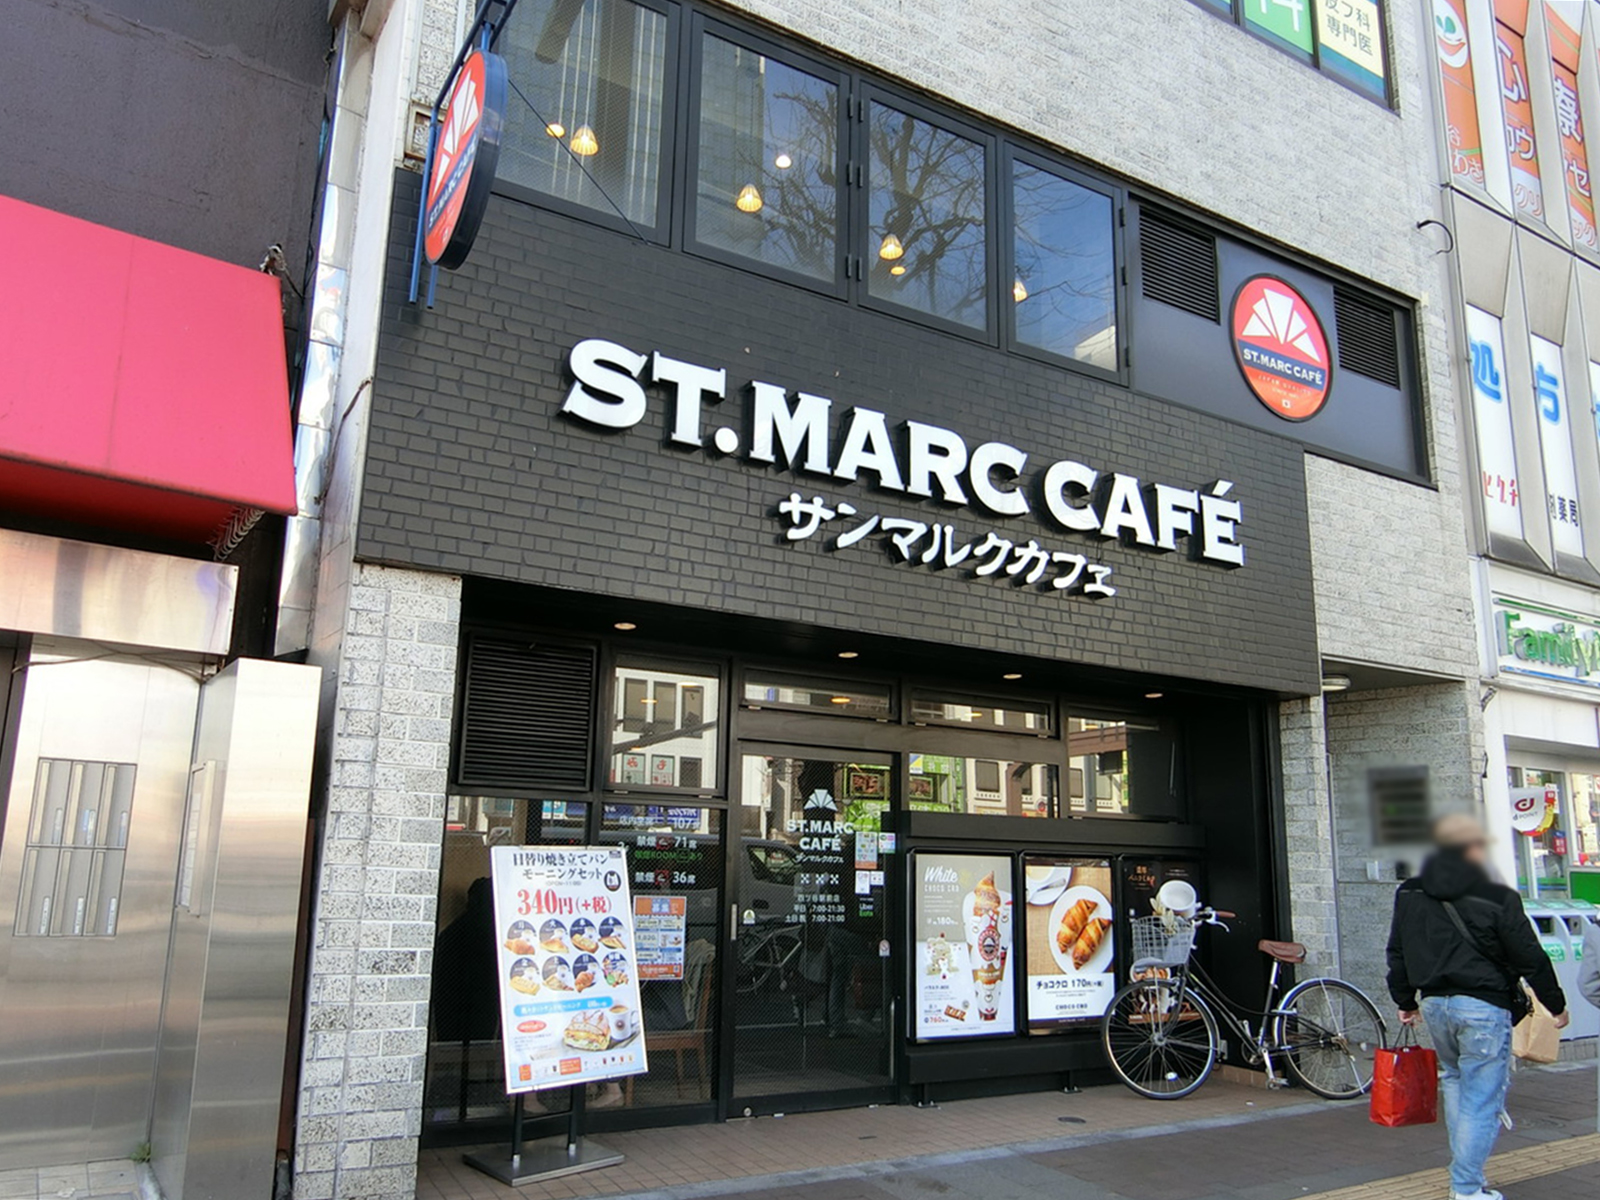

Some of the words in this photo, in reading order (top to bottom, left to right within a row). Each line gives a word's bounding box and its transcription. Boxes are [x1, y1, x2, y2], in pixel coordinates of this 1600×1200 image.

[1326, 14, 1374, 57] 専門医
[1243, 348, 1293, 375] ST.MARC
[1293, 366, 1323, 385] CAFÉ
[562, 338, 1031, 516] ST.MARC
[1044, 460, 1245, 567] CAFÉ
[779, 492, 1117, 597] サンマルクカフェ
[786, 819, 855, 834] ST.MARC
[799, 833, 842, 852] CAFÉ
[522, 868, 602, 880] モーニングセット
[923, 865, 959, 883] White
[1036, 979, 1069, 990] チョコクロ
